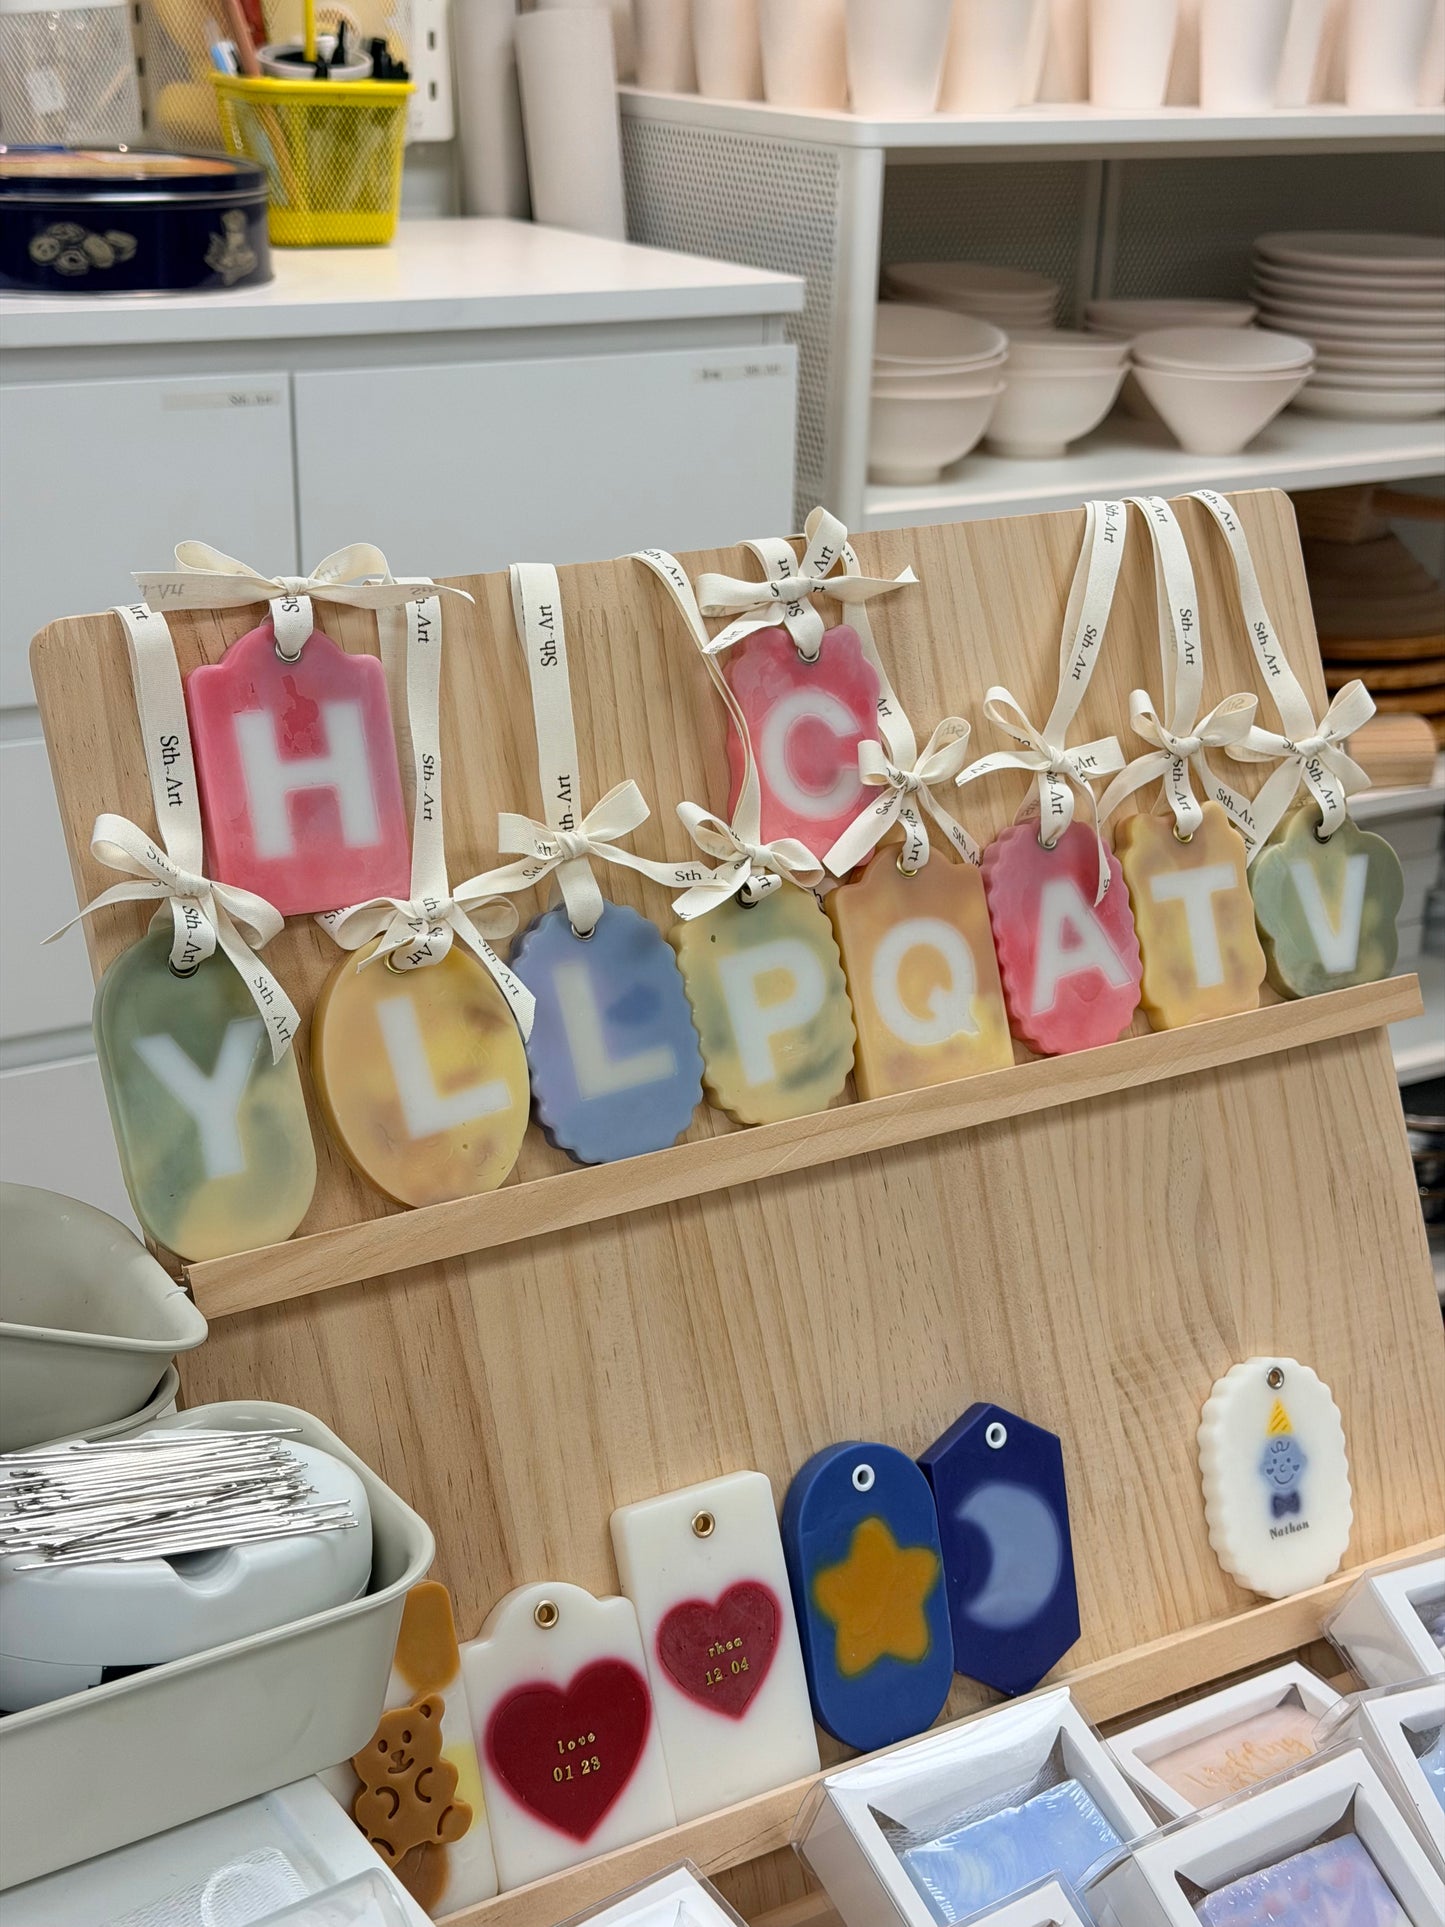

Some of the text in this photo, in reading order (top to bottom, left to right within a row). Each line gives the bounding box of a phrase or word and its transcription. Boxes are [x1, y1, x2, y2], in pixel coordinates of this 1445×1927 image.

[234, 701, 382, 858] H
[760, 688, 864, 821] C
[1031, 877, 1133, 1016] A
[1149, 863, 1238, 987] T
[1291, 853, 1369, 974] V
[551, 957, 678, 1101] L
[716, 938, 826, 1088] P
[870, 916, 980, 1047] Q
[132, 1018, 266, 1179] Y
[376, 995, 514, 1141] L
[1269, 1521, 1309, 1540] Nathan
[708, 1637, 743, 1658] rhea
[553, 1756, 601, 1782] 01 23
[557, 1732, 596, 1754] love
